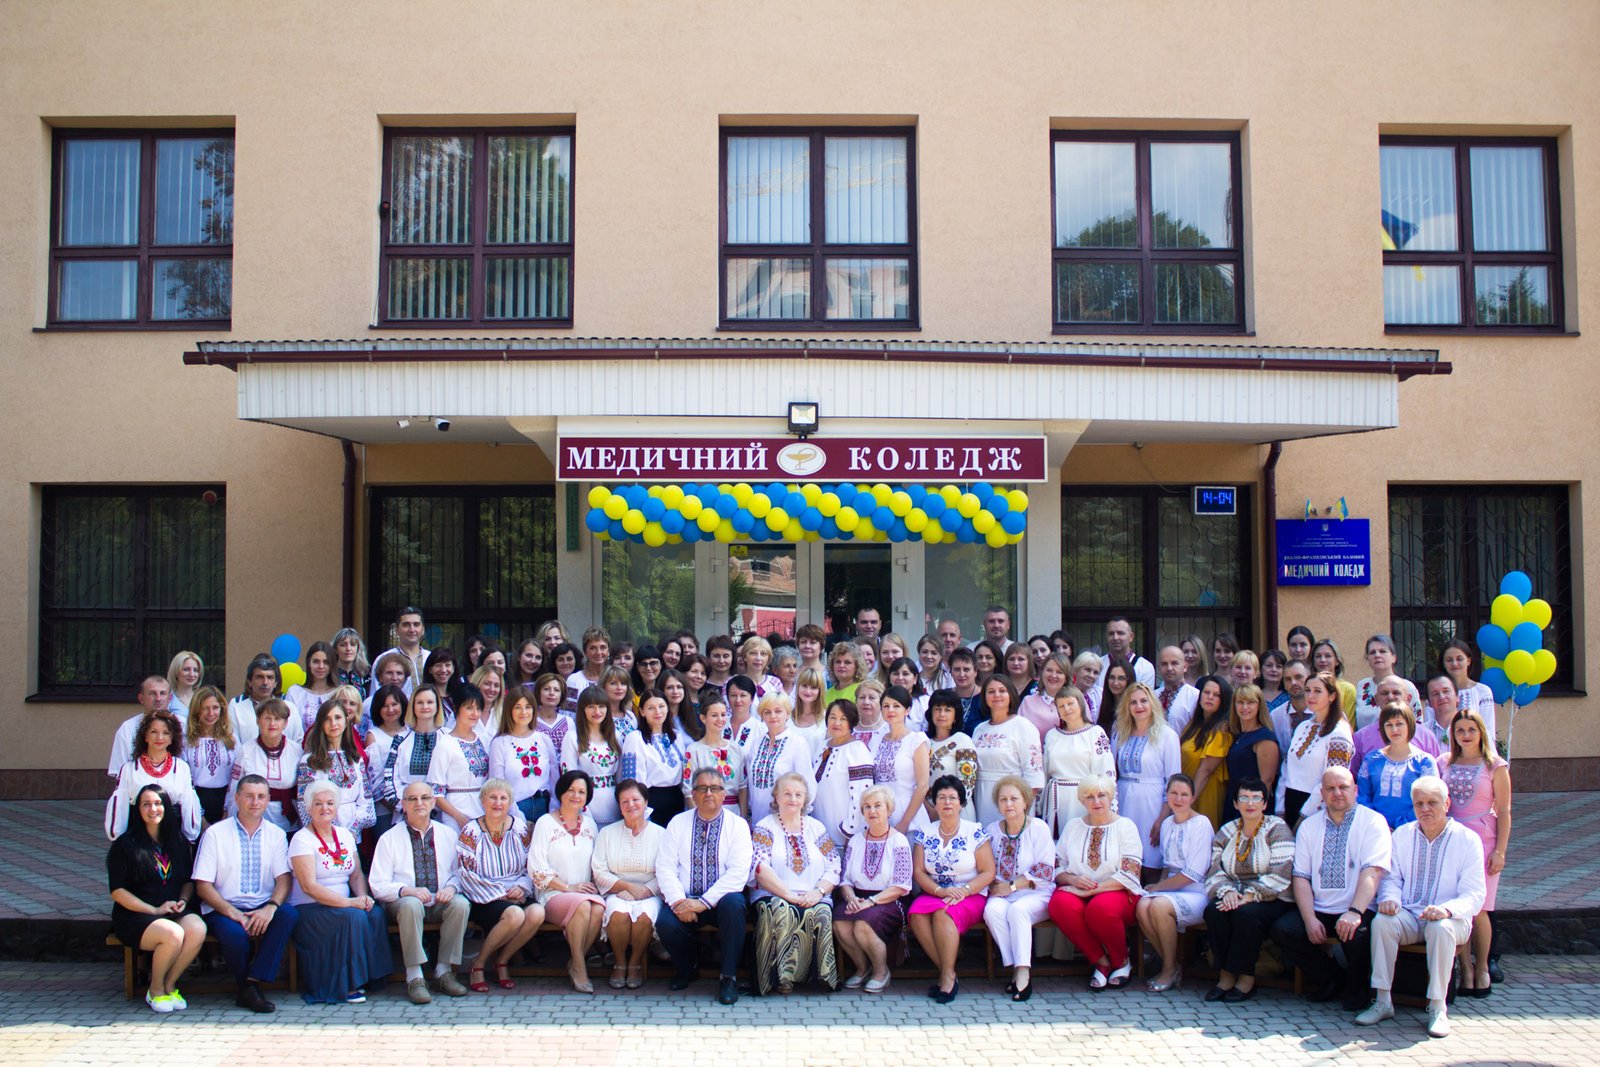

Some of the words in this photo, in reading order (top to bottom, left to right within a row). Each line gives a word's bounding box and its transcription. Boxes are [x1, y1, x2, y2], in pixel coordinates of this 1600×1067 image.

[566, 442, 768, 475] МЕДИЧНИЙ
[848, 446, 1023, 475] КОЛЕДЖ
[1284, 563, 1330, 579] МЕДИЧНИЙ
[1334, 564, 1365, 579] КОЛЕДЖ
